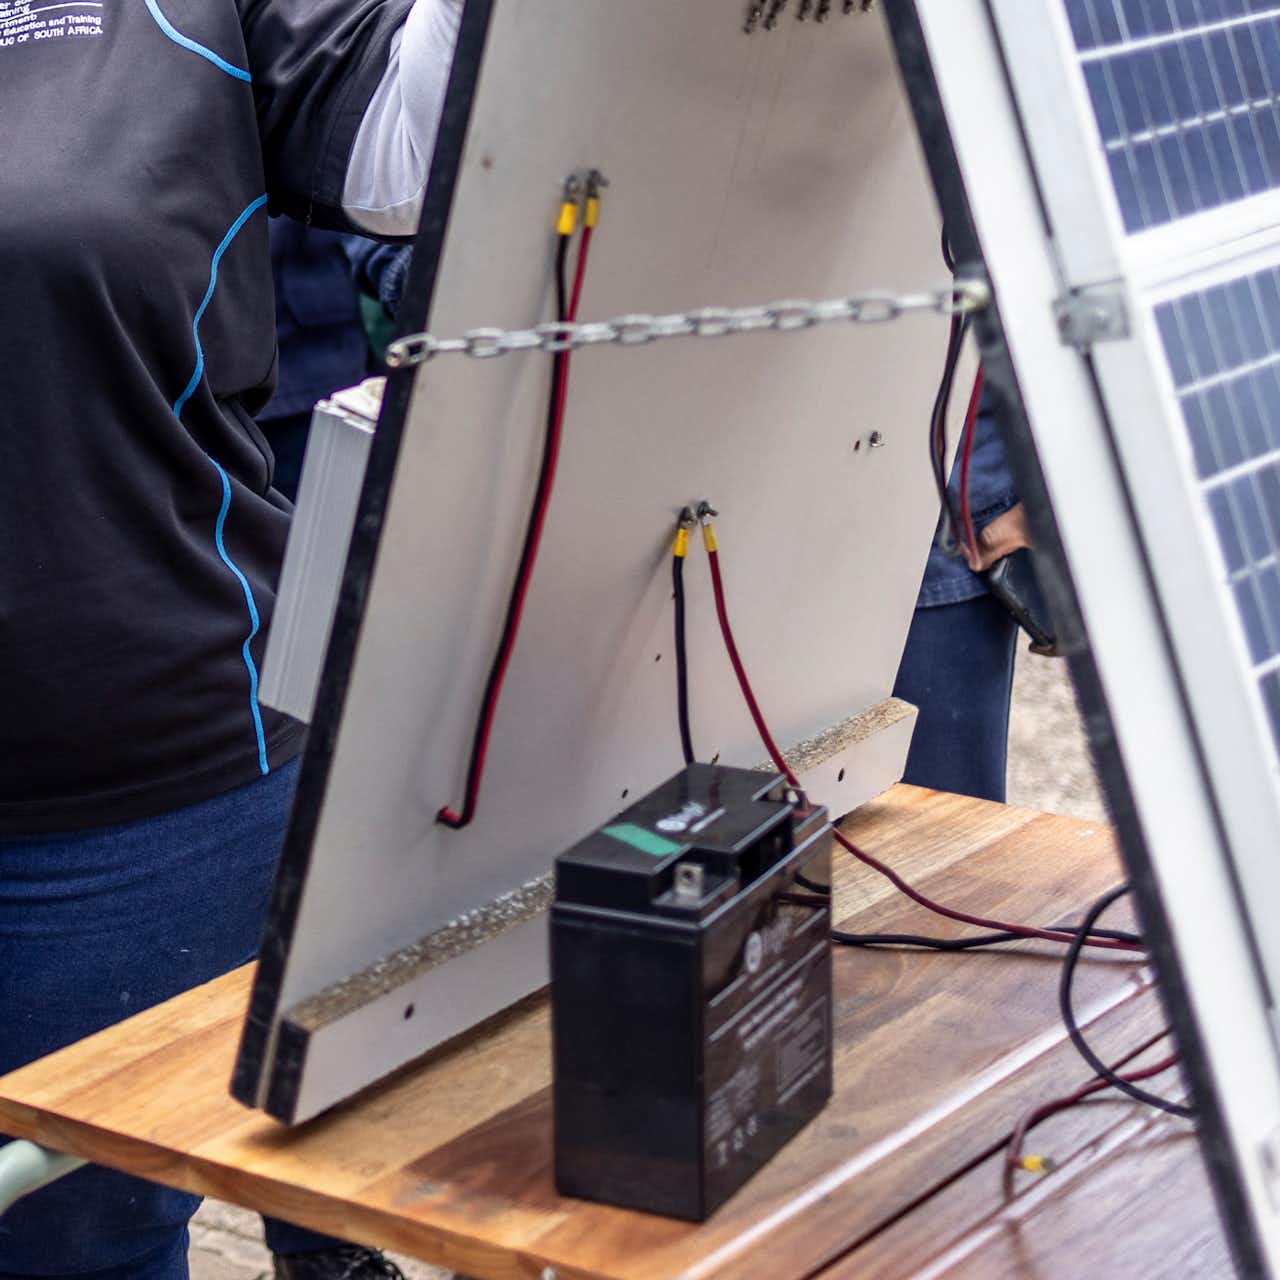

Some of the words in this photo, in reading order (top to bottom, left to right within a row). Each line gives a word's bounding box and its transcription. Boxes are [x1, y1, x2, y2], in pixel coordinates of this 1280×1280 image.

[3, 21, 47, 37] Education
[48, 17, 67, 27] and
[66, 14, 102, 26] Training
[16, 33, 31, 44] OF
[33, 27, 65, 40] SOUTH
